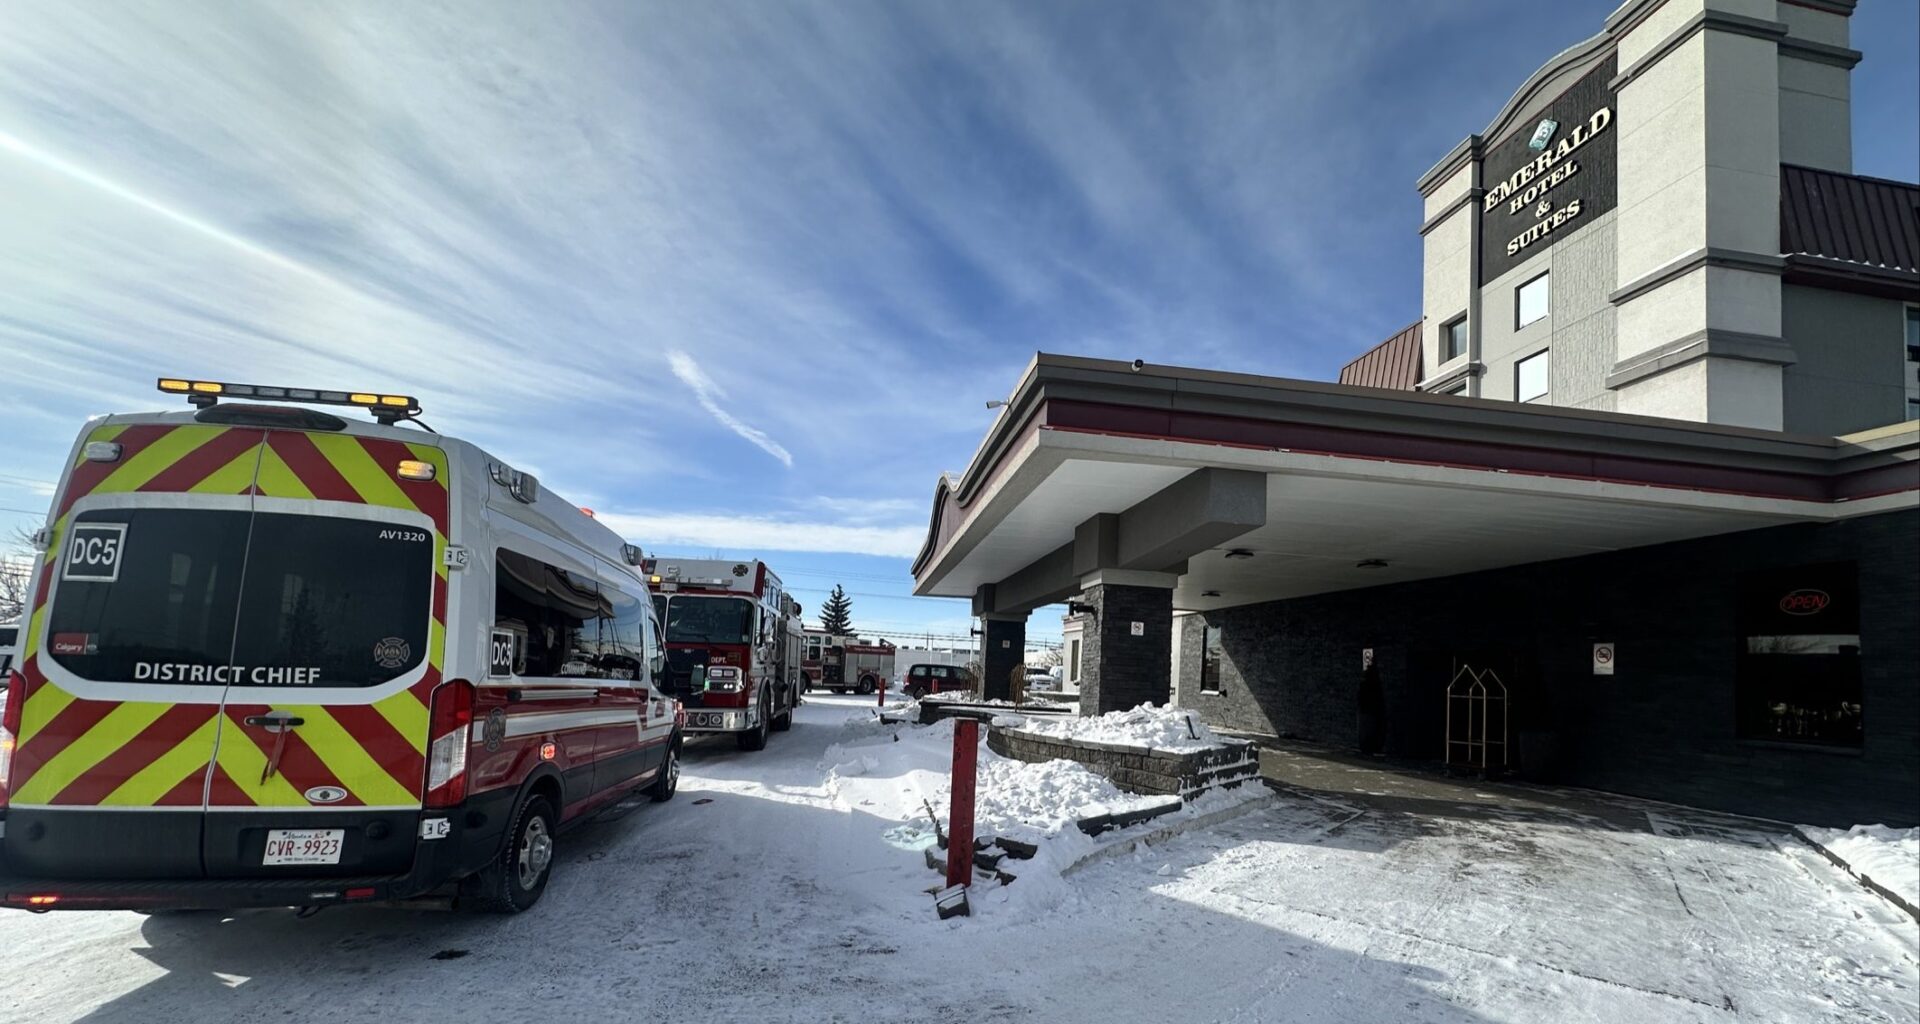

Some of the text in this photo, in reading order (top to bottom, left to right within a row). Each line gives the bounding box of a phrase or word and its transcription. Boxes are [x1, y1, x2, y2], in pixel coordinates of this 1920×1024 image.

[1484, 106, 1611, 213] EMERALD
[1509, 160, 1578, 215] HOTEL
[1535, 199, 1552, 218] &
[1507, 199, 1581, 256] SUITES
[379, 529, 426, 542] AV1320
[71, 536, 117, 566] DC5
[1782, 594, 1825, 609] OPEN
[55, 643, 83, 652] Calgary
[492, 641, 512, 666] DC5
[711, 656, 727, 664] DEPT.
[134, 662, 321, 684] DISTRICT CHIEF
[267, 840, 339, 857] CVR-9923
